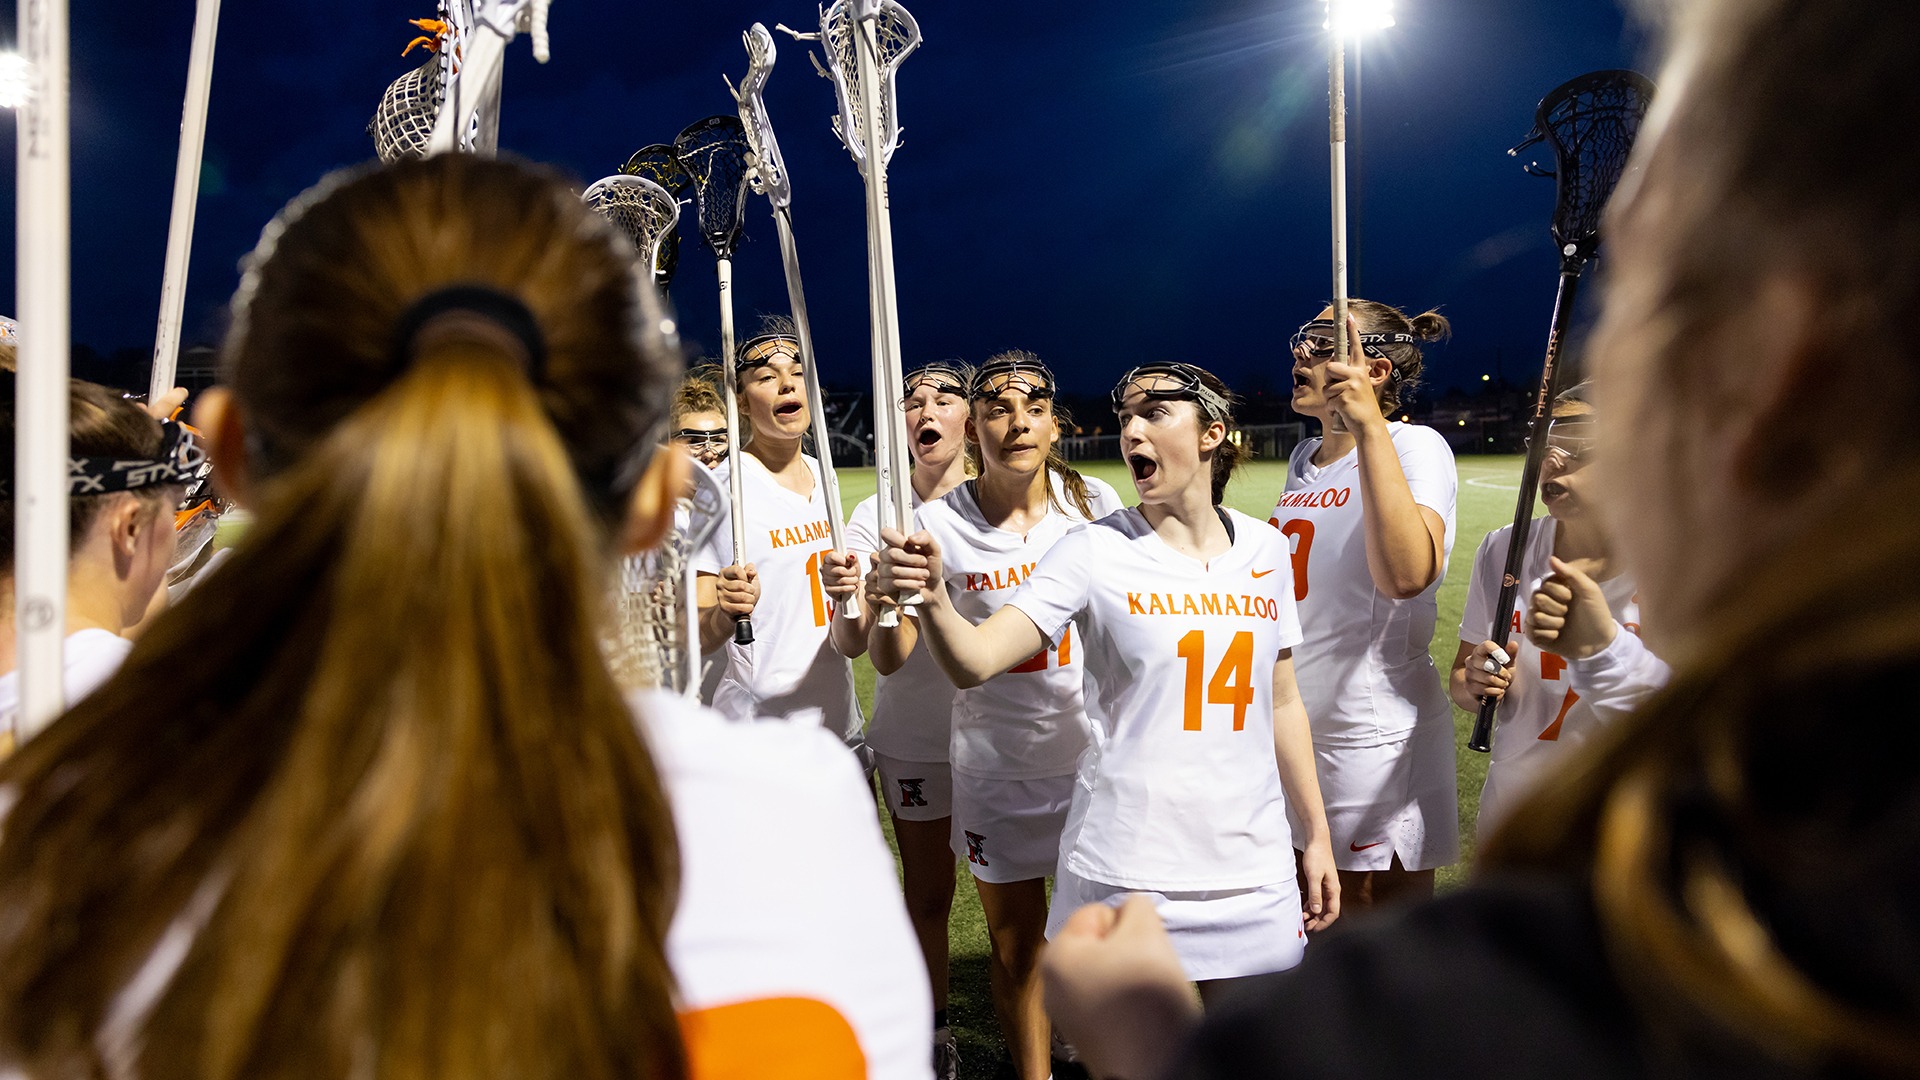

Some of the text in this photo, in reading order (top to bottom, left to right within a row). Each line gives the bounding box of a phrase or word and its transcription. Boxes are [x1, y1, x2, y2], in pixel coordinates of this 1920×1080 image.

[1360, 333, 1386, 343] STX
[1365, 345, 1387, 358] ST
[1536, 329, 1560, 417] MAVERIK
[126, 460, 178, 488] STX
[1127, 591, 1278, 621] KALAMAZOO
[1177, 629, 1254, 731] 14
